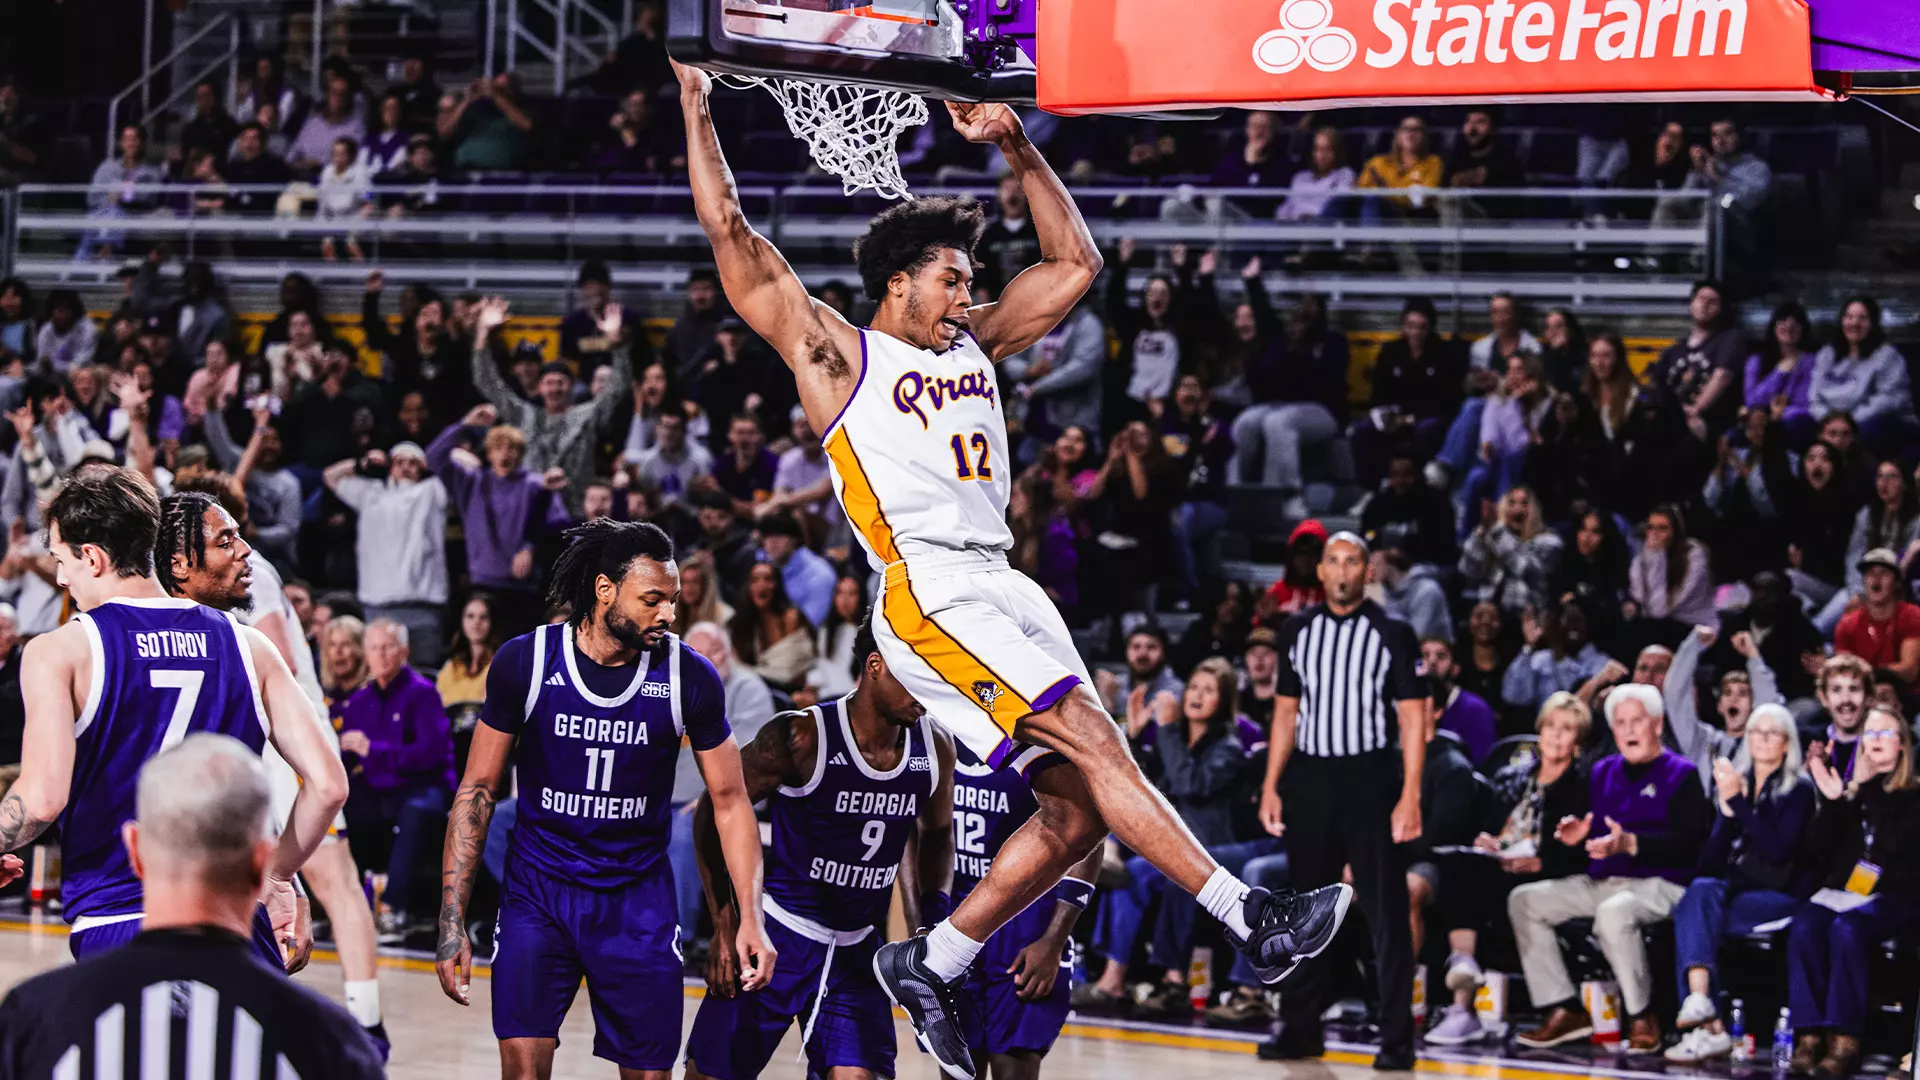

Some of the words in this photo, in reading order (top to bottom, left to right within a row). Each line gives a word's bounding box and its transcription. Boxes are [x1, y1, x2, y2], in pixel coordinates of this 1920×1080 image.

[892, 368, 994, 431] Pirat
[950, 432, 993, 482] 12
[135, 630, 207, 658] SOTIROV
[641, 681, 670, 698] SBC
[149, 669, 205, 754] 7
[554, 713, 649, 745] GEORGIA
[585, 748, 615, 792] 11
[541, 787, 648, 819] SOUTHERN
[835, 791, 916, 816] GEORGIA
[953, 784, 1010, 814] ORGIA
[860, 820, 886, 862] 9
[952, 811, 986, 854] 12
[809, 857, 899, 890] SOUTHERN
